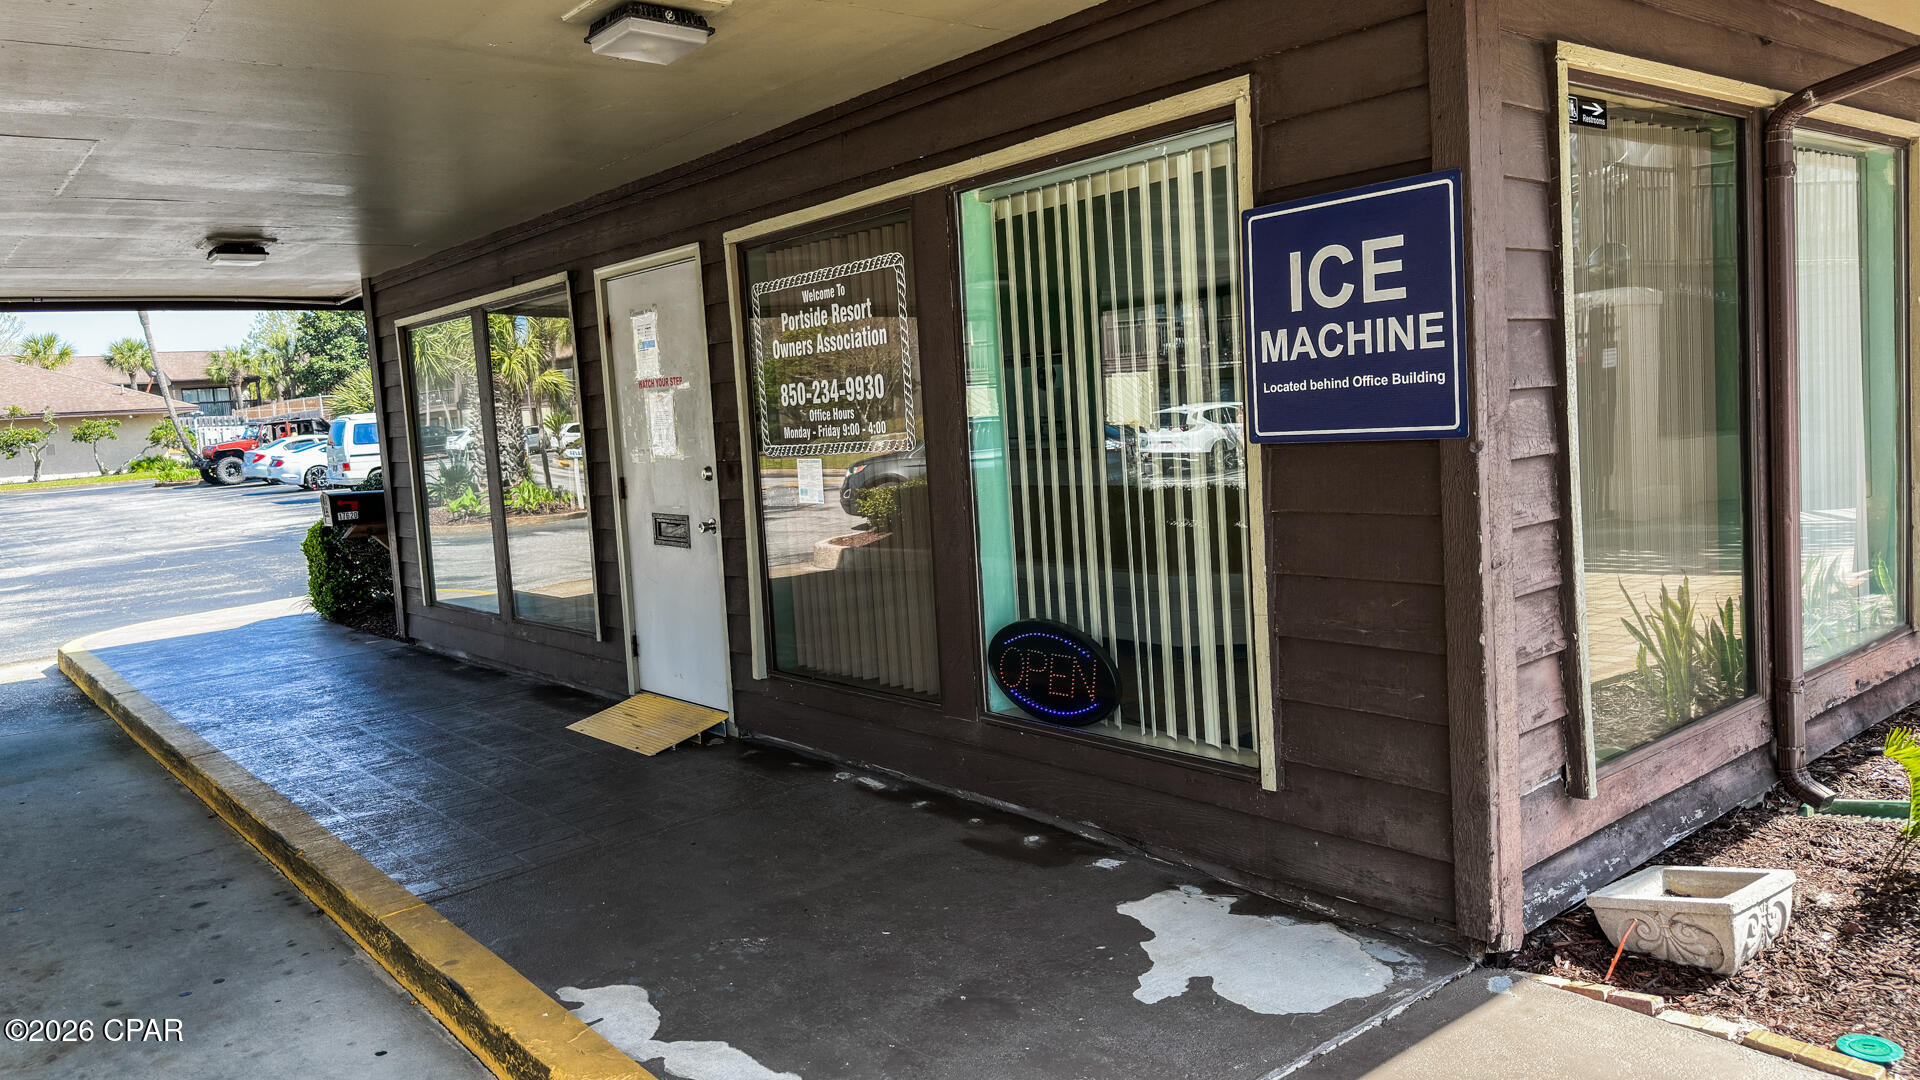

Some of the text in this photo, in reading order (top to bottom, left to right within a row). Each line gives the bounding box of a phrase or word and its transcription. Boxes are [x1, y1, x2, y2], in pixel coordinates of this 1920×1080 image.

[1582, 113, 1606, 126] Restrooms
[1289, 234, 1407, 313] ICE
[801, 283, 846, 303] Welcome To
[780, 297, 873, 332] Portside Resort
[772, 325, 888, 360] Owners Association
[1260, 311, 1446, 363] MACHINE
[638, 376, 683, 389] WATCH YOUR STEP
[780, 373, 885, 407] 850-234-9930
[1263, 371, 1446, 394] Located behind Office Building
[809, 408, 855, 422] Office Hours
[783, 426, 811, 441] Monday
[818, 425, 841, 440] Friday
[842, 423, 860, 437] 9:00
[868, 421, 886, 434] 4:00
[1000, 646, 1097, 702] OPEN
